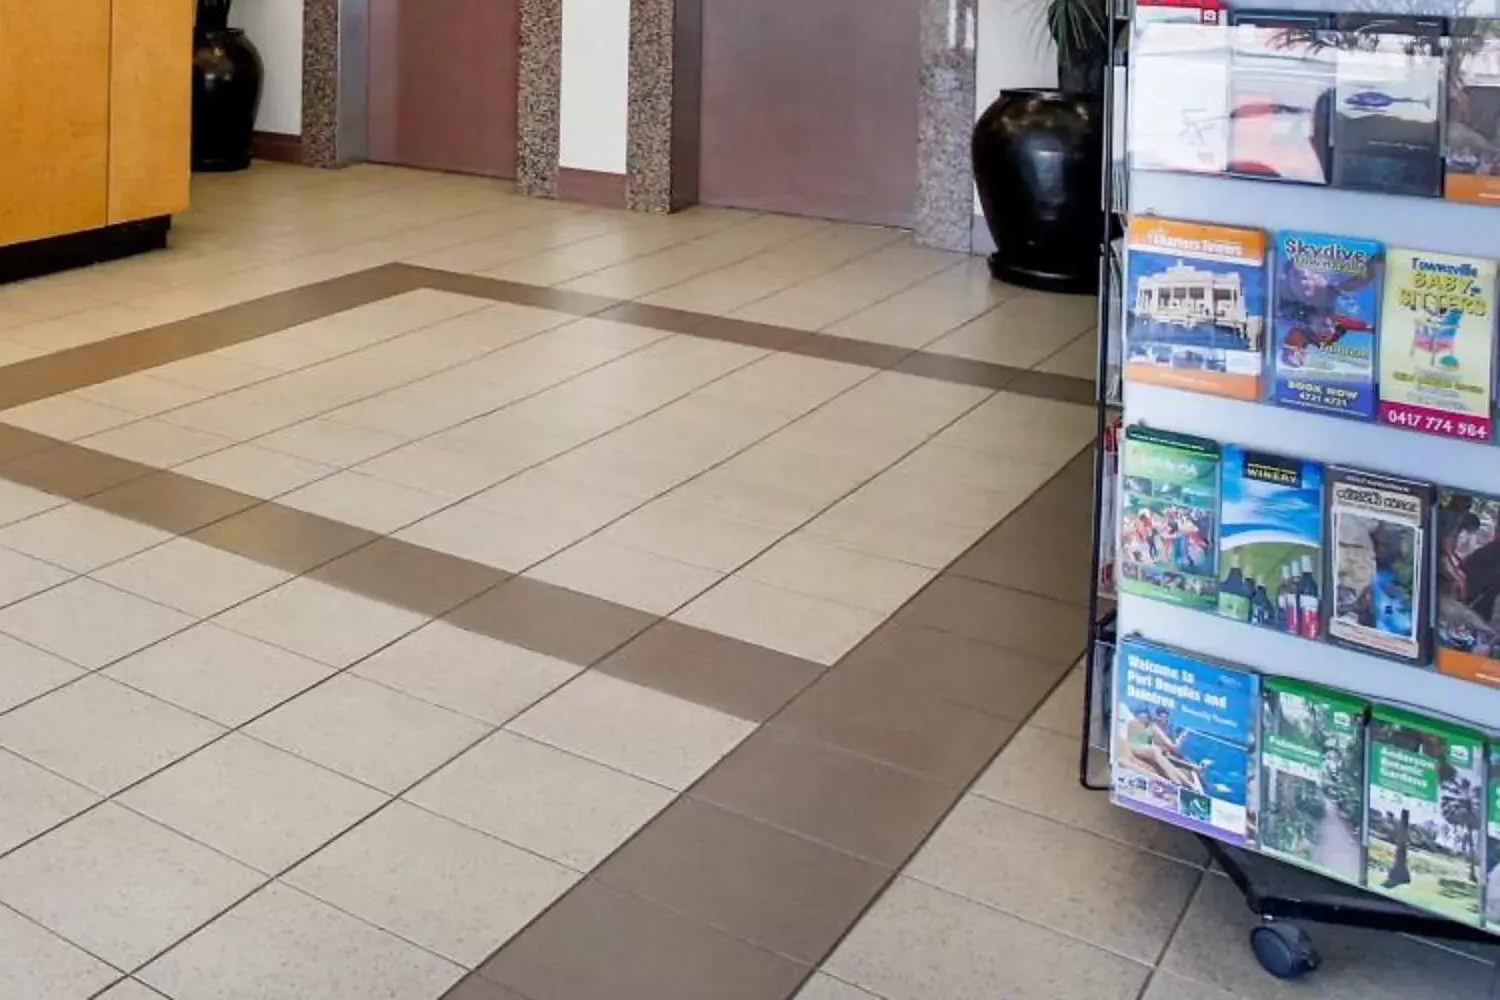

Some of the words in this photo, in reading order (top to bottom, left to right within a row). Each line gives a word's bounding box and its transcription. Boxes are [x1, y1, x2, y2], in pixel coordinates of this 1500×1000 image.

[1285, 238, 1366, 263] Skydive
[1411, 257, 1478, 277] Townsville
[1387, 409, 1420, 427] 0417
[1424, 415, 1453, 433] 774
[1247, 467, 1297, 484] WINERY
[1127, 654, 1179, 679] Welcome
[1182, 669, 1195, 685] to
[1127, 669, 1153, 686] Port
[1155, 676, 1200, 701] Douglas
[1203, 692, 1228, 709] and
